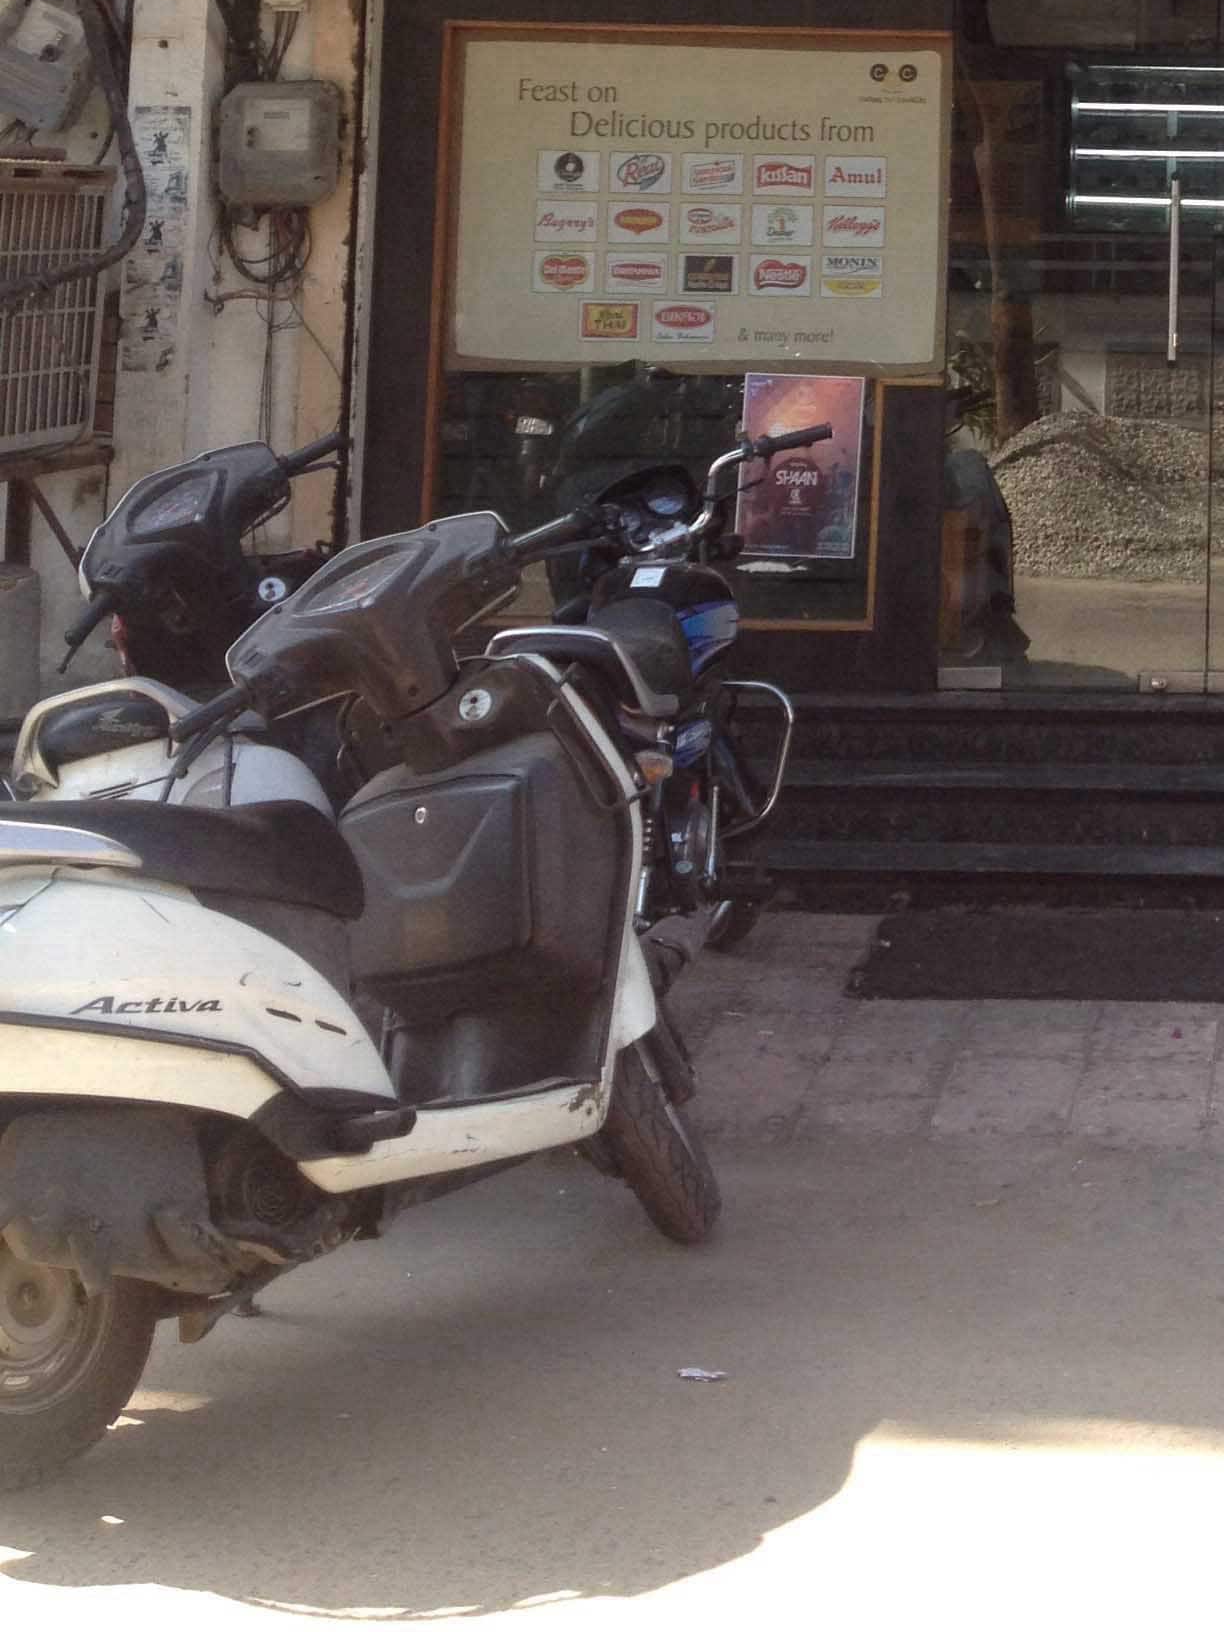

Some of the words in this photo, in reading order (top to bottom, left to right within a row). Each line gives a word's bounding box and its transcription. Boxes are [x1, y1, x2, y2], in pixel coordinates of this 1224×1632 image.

[519, 78, 578, 103] Feast
[587, 83, 617, 103] on
[570, 110, 695, 140] Delicious
[704, 116, 811, 148] products
[820, 117, 875, 143] from
[830, 166, 882, 184] Amul
[738, 328, 749, 343] &
[754, 329, 788, 347] many
[776, 470, 817, 486] SHAAN
[70, 995, 223, 1015] Activa
